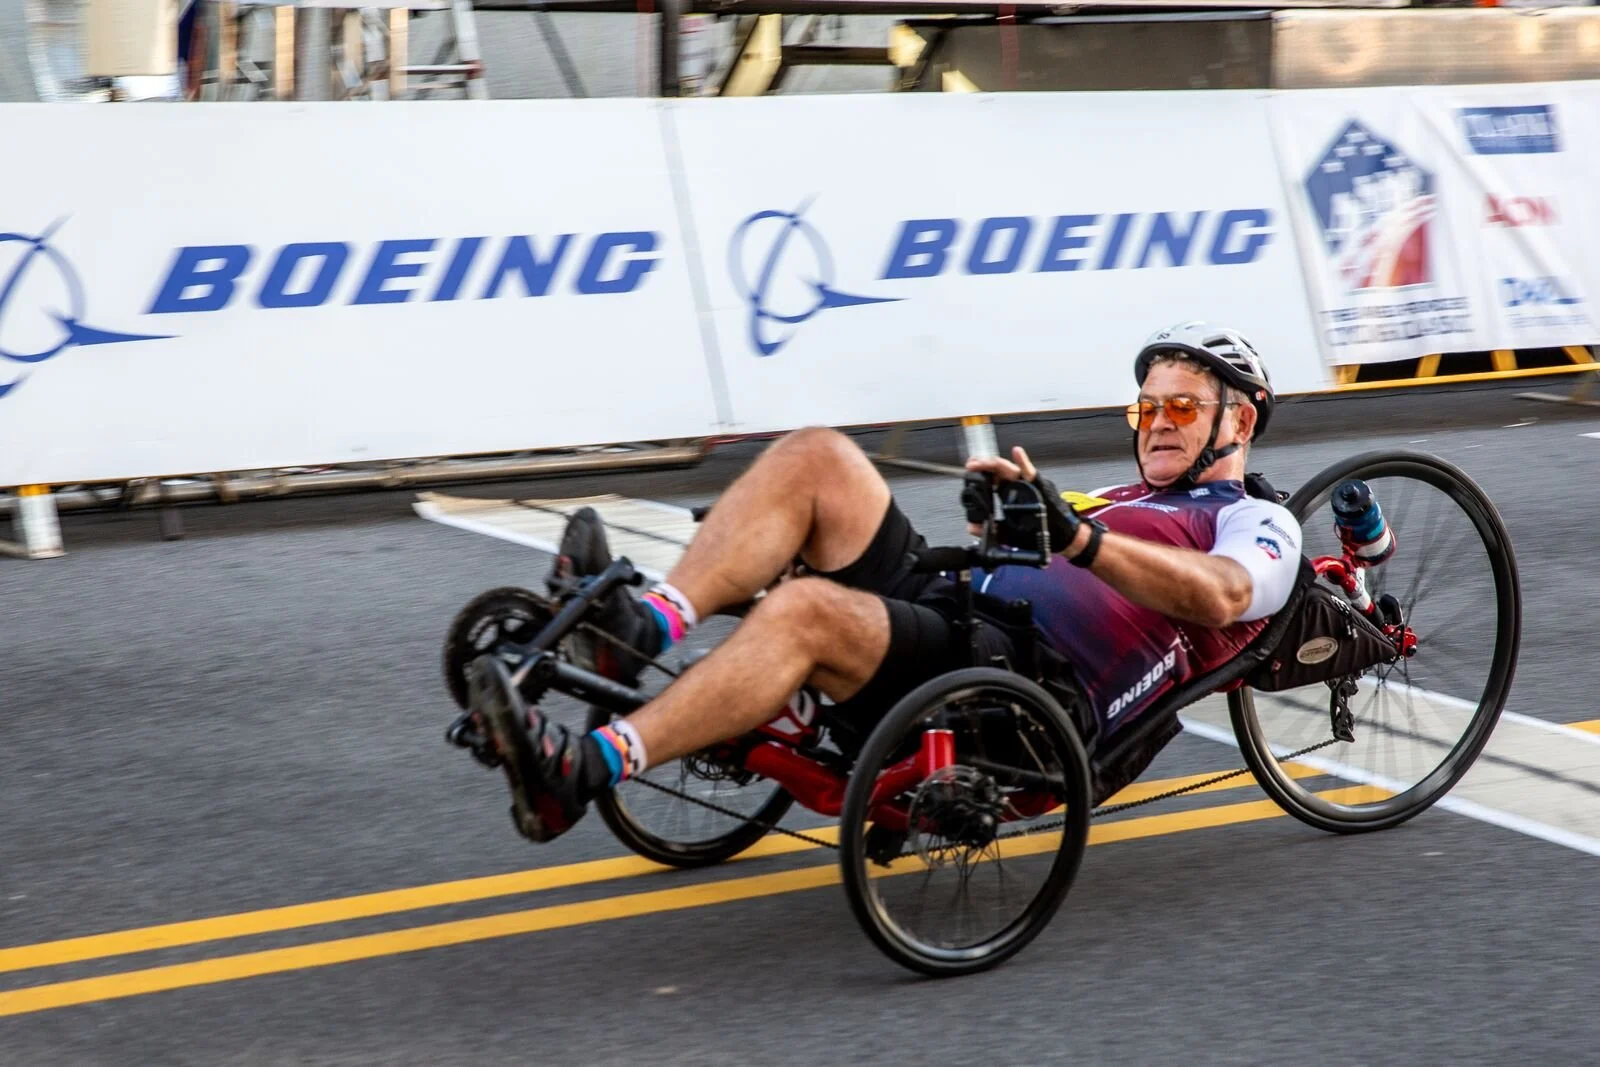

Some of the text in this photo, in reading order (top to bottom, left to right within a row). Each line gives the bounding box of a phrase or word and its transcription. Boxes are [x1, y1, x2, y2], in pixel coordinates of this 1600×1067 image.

[143, 230, 664, 315] BOEING
[876, 208, 1277, 281] BOEING
[1107, 650, 1175, 719] BOEING
